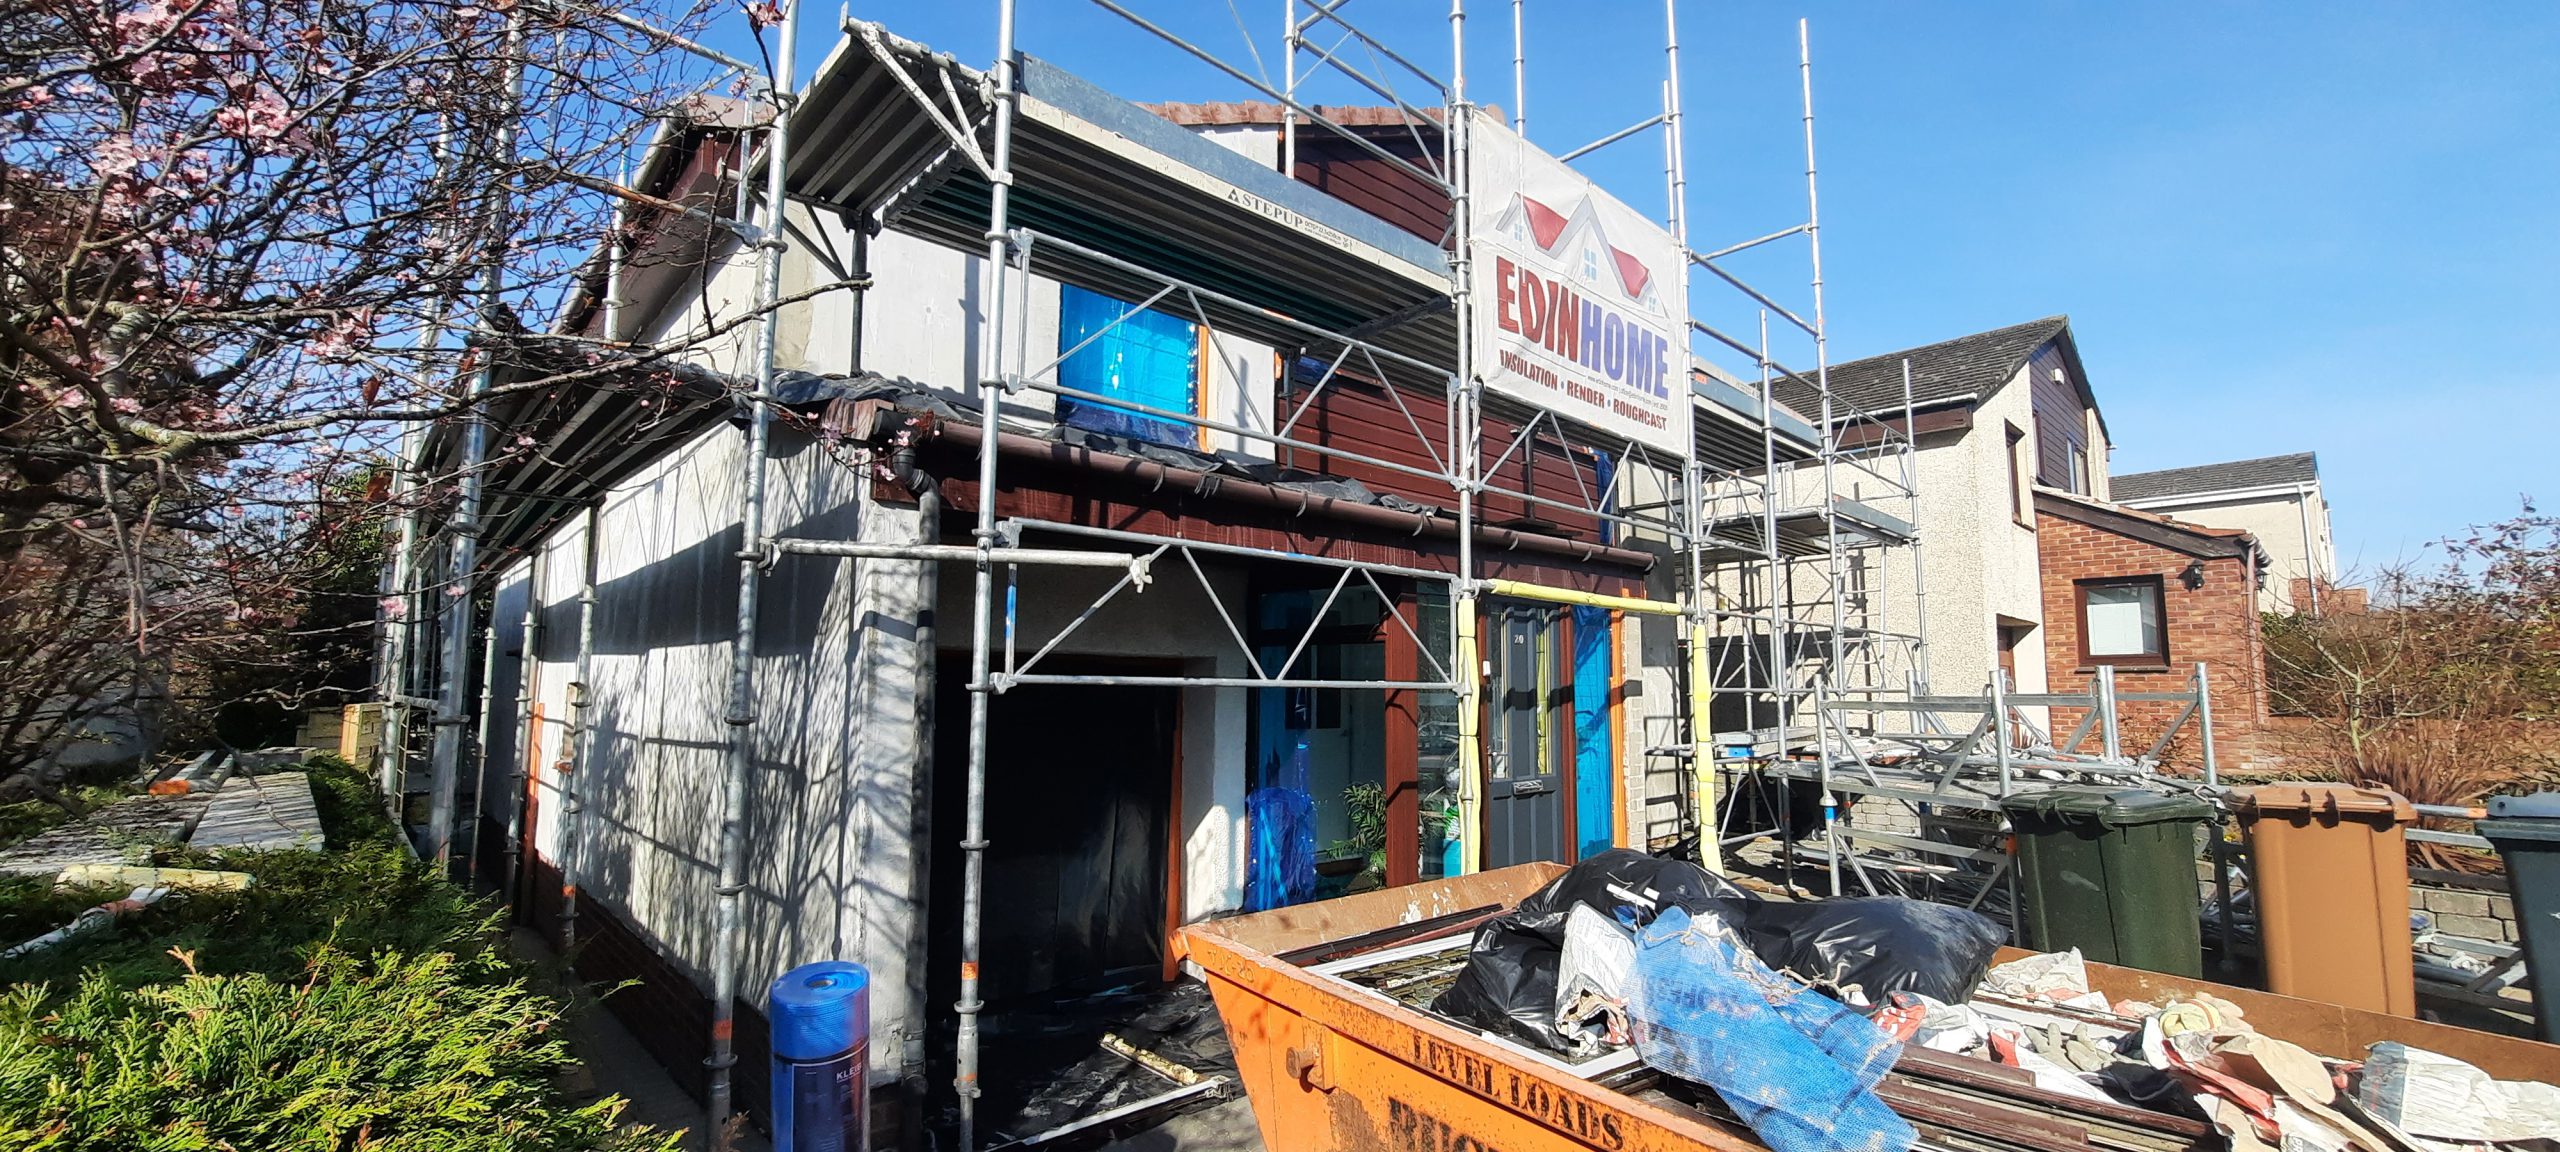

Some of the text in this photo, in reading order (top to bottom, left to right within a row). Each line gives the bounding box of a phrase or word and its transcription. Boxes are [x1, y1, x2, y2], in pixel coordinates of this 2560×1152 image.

[1241, 192, 1303, 228] STEPUP
[1496, 255, 1669, 400] EDINHOME
[1499, 349, 1558, 391] INSULATION
[1567, 379, 1605, 409] RENDER
[1613, 398, 1667, 431] ROUGHCAST
[1514, 634, 1524, 644] 20
[1412, 1031, 1500, 1097] LEVEL
[1510, 1073, 1625, 1151] LOADS
